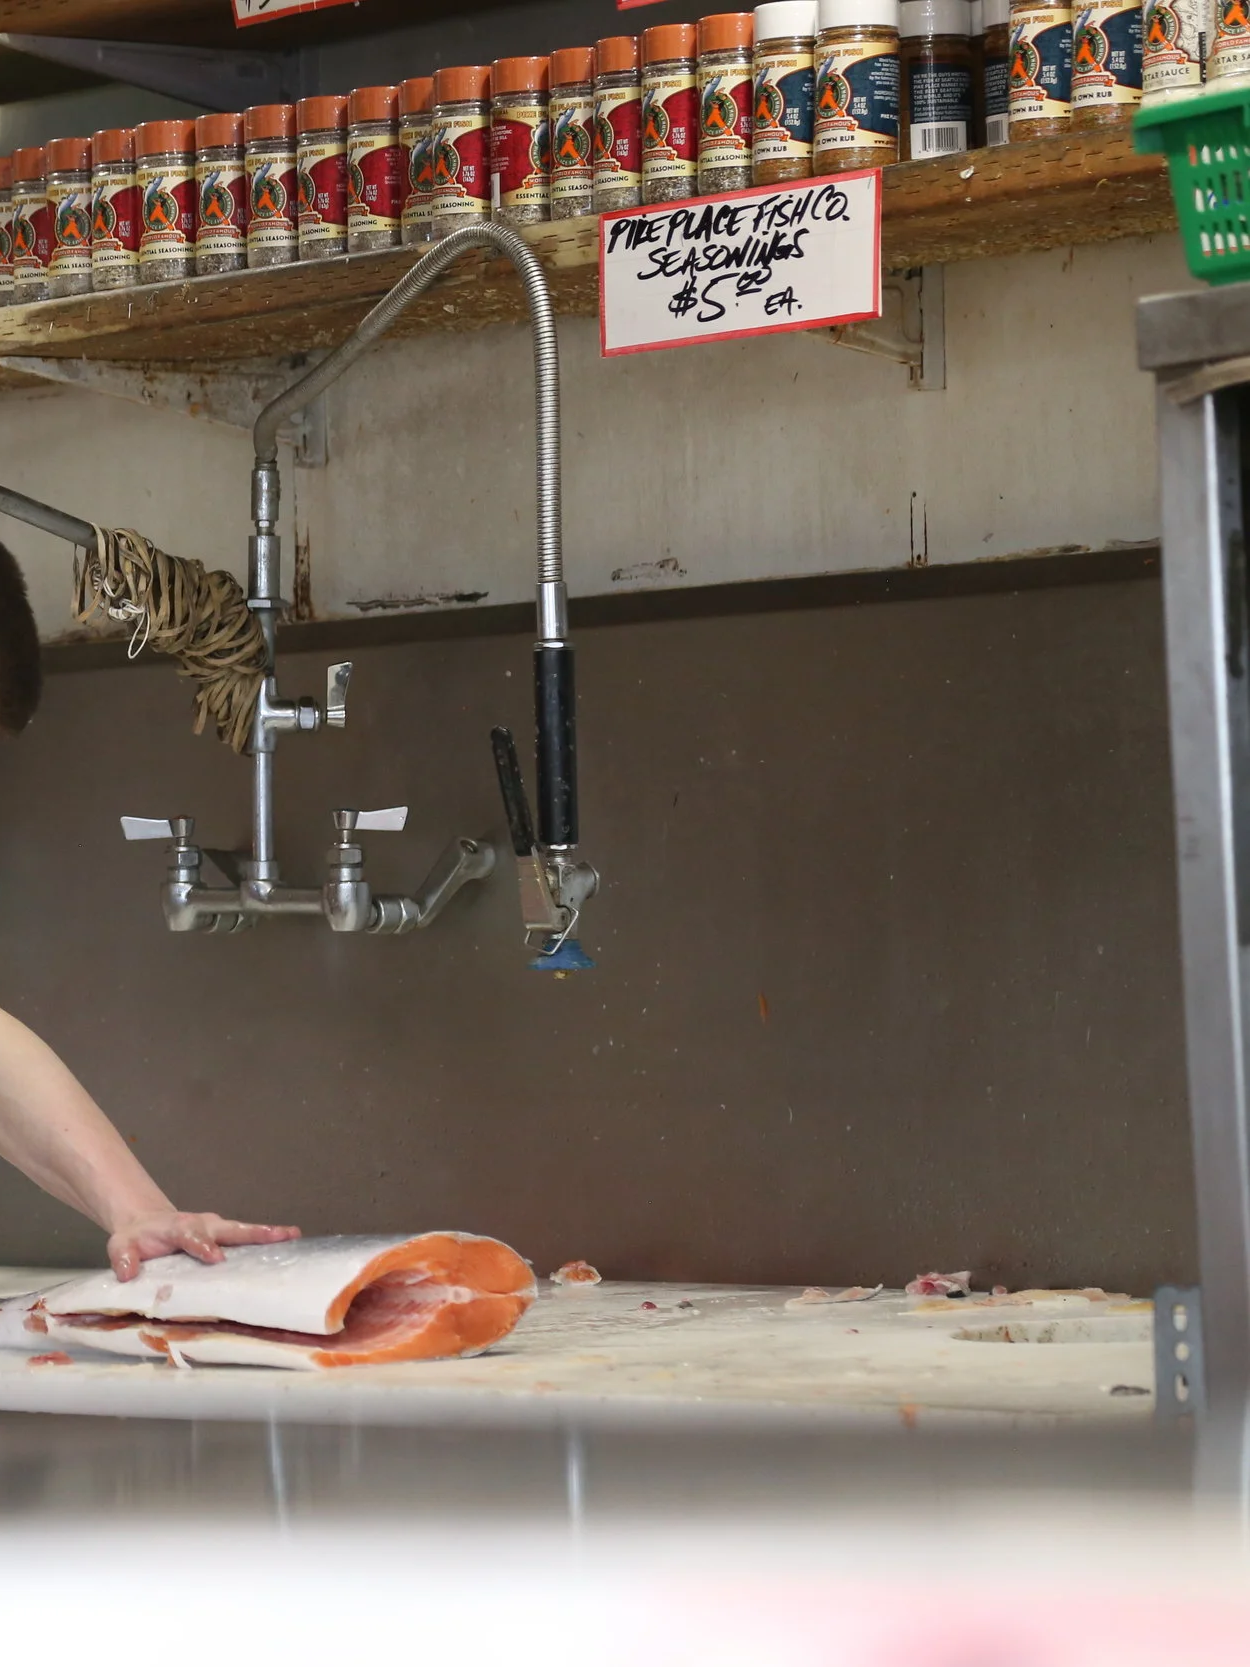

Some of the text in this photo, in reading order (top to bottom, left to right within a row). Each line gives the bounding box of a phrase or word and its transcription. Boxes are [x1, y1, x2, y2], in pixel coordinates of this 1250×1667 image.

[1161, 68, 1190, 77] SAUCE
[821, 136, 837, 144] OWN
[651, 164, 686, 173] SEASONING
[440, 201, 474, 209] SEASONING
[665, 204, 749, 246] PLACE
[748, 190, 814, 233] FISH
[637, 228, 810, 281] SEASONINGS
